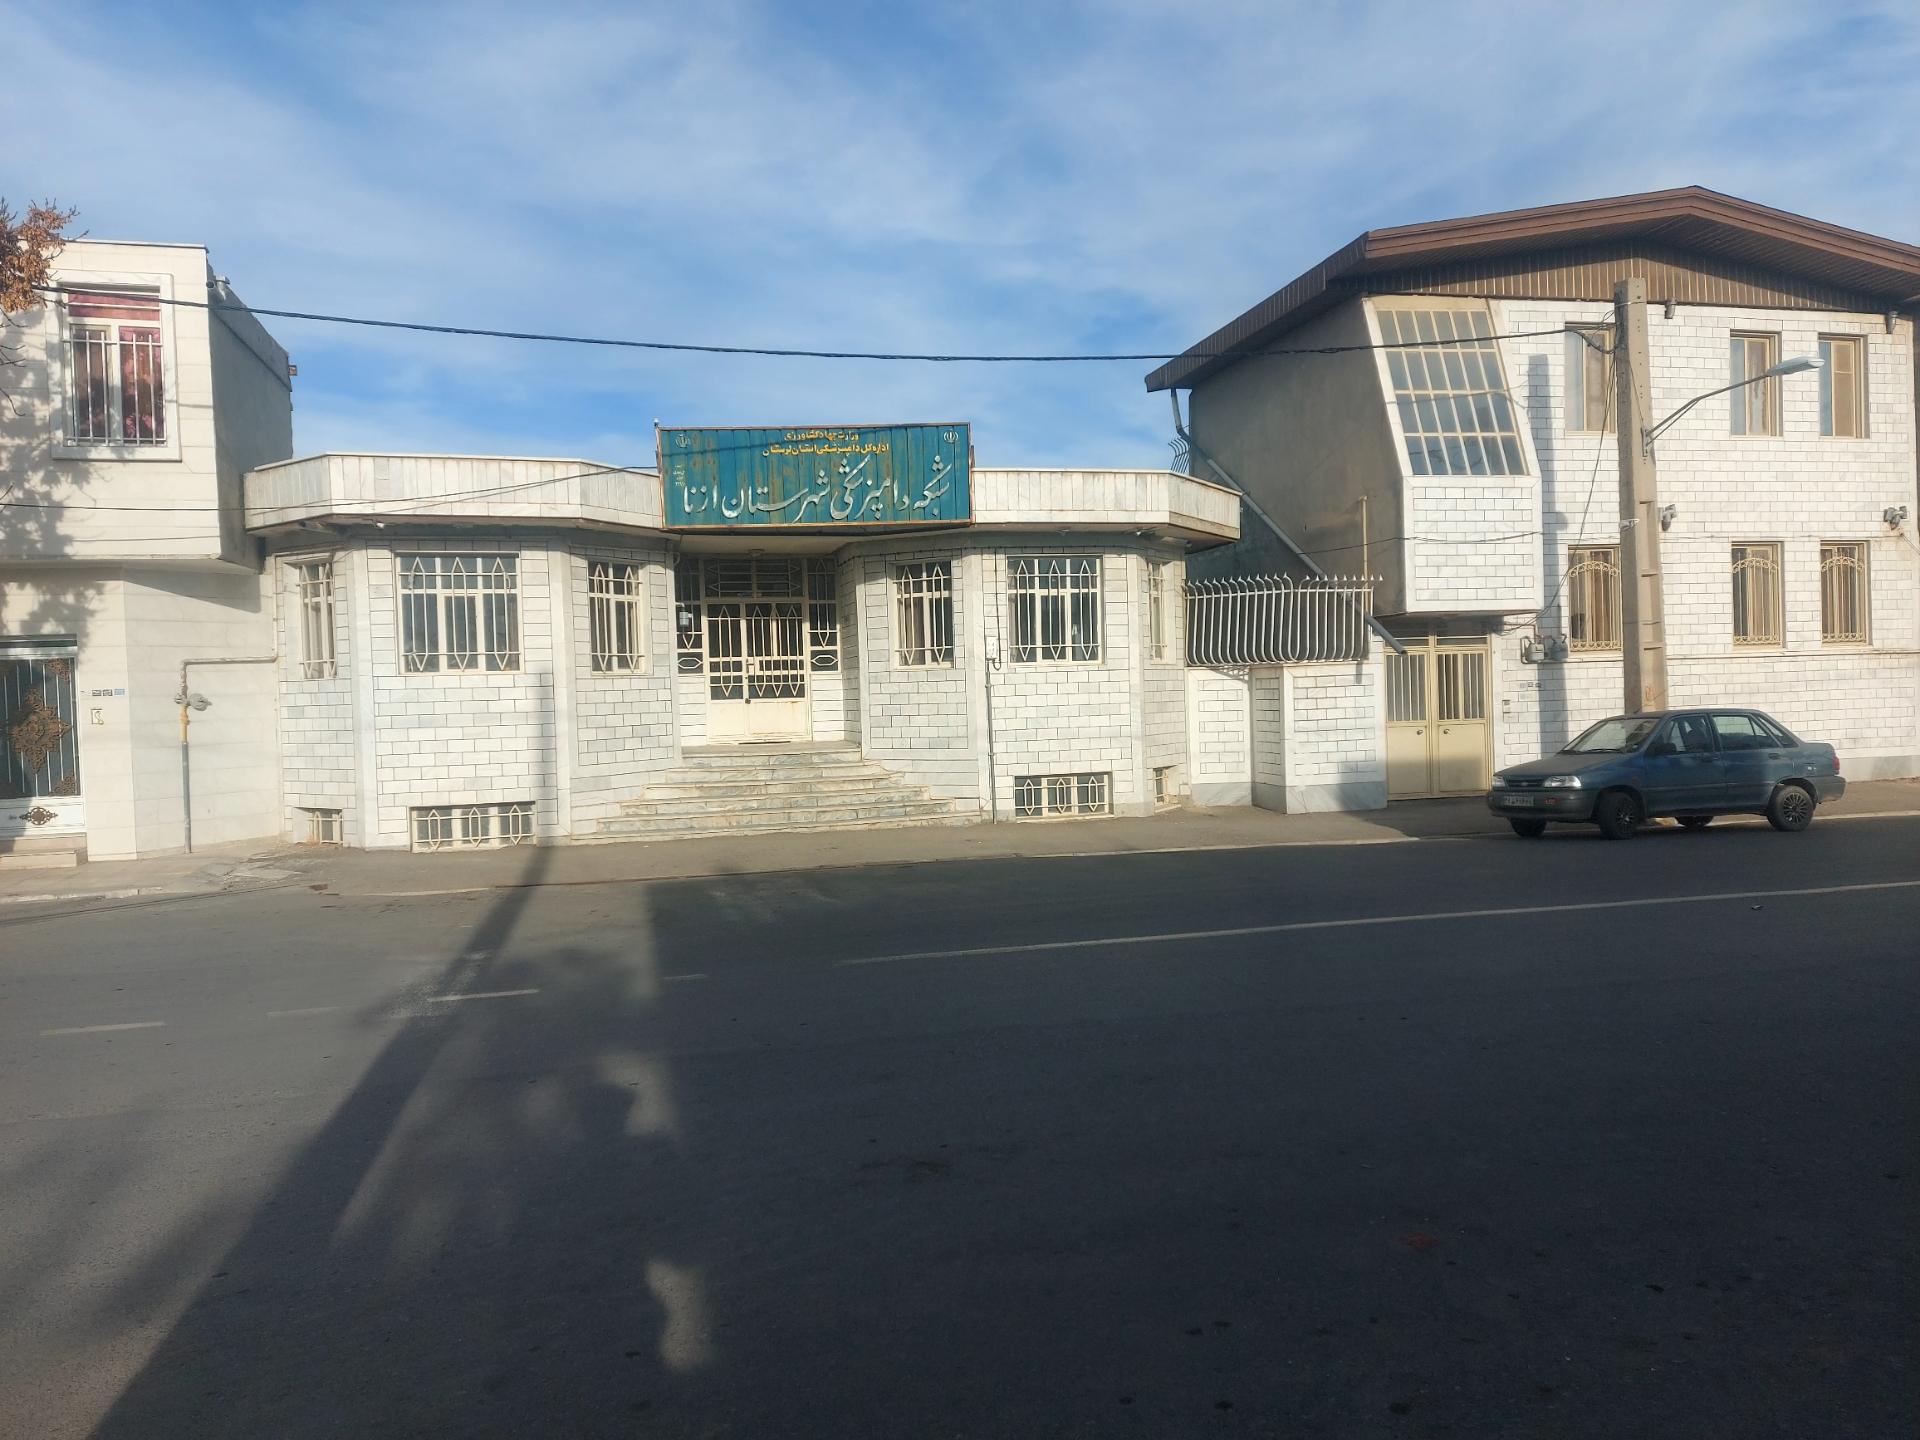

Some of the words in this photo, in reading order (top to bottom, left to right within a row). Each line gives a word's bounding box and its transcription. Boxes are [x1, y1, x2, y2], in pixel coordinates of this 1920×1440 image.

[683, 476, 718, 514] ازنا
[721, 469, 831, 523] شهرستان
[831, 454, 910, 521] دامپزشکی
[913, 455, 952, 517] شبکه
